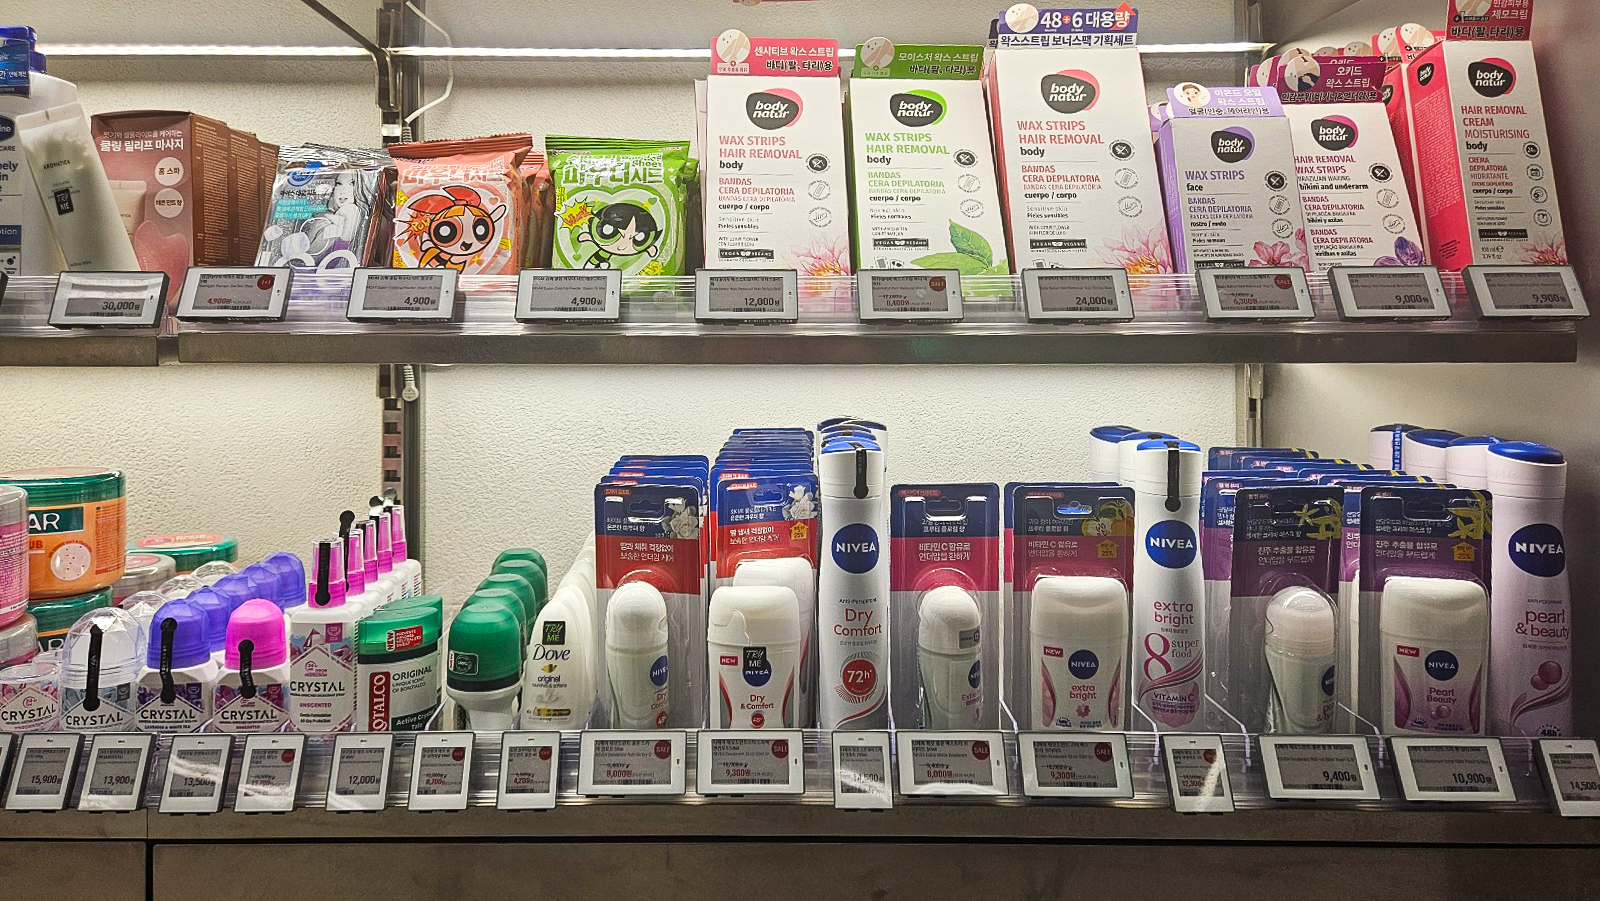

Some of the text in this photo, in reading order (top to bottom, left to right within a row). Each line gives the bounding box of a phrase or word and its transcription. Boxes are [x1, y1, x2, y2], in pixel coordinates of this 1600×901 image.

[1085, 12, 1131, 29] 대용량
[1000, 35, 1050, 47] 왁스스트립
[1052, 35, 1092, 47] 보너스팩
[1094, 34, 1133, 46] 기획세트
[754, 46, 834, 60] 센시티브 왁스 스트립
[898, 53, 978, 62] 모이스처 왁스 스트립
[1336, 66, 1362, 76] 오키드
[1476, 70, 1504, 81] body
[1326, 78, 1370, 89] 왁스 스트립
[1475, 78, 1506, 87] natur
[1051, 83, 1085, 95] body
[1049, 93, 1087, 102] natur
[755, 100, 788, 113] body
[898, 100, 932, 112] body
[1460, 105, 1527, 115] HAIR REMOVAL
[752, 110, 790, 120] natur
[897, 108, 934, 117] natur
[1017, 121, 1086, 131] WAX STRIPS
[1462, 118, 1494, 126] CREAM
[1319, 125, 1346, 135] body
[719, 135, 786, 146] WAX STRIPS
[865, 133, 932, 142] WAX STRIPS
[1019, 134, 1105, 144] HAIR REMOVAL
[1318, 133, 1348, 142] natur
[99, 138, 184, 152] 쿨링 릴리프 마사지
[1218, 138, 1243, 148] body
[1466, 141, 1488, 152] body
[719, 148, 802, 159] HAIR REMOVAL
[866, 144, 950, 155] HAIR REMOVAL
[1020, 147, 1045, 157] body
[1217, 145, 1246, 153] natur
[866, 155, 891, 165] body
[1316, 155, 1356, 164] REMOVAL
[719, 160, 744, 171] body
[1021, 165, 1056, 173] BANDAS
[1314, 166, 1346, 174] STRIPS
[868, 171, 901, 179] BANDAS
[1023, 175, 1101, 183] CERA DEPILATORIA
[1185, 170, 1245, 180] WAX STRIPS
[719, 178, 752, 186] BANDAS
[1186, 183, 1203, 191] face
[741, 187, 795, 195] DEPILATORIA
[1024, 192, 1077, 200] cuerpo corpo
[1187, 197, 1216, 205] BANDAS
[718, 204, 743, 212] cuerpo
[836, 542, 877, 553] NIVEA
[919, 542, 940, 552] 비타민
[941, 543, 948, 551] C
[1028, 540, 1049, 549] 비타민
[1050, 541, 1057, 549] C
[1149, 538, 1194, 549] NIVEA
[1515, 541, 1564, 554] NIVEA
[1153, 600, 1194, 612] extra
[845, 608, 874, 624] Dry
[1154, 612, 1194, 628] bright
[1525, 610, 1565, 625] pearl
[834, 624, 882, 637] Comfort
[1530, 625, 1571, 640] beauty
[546, 633, 560, 643] ME
[1171, 639, 1199, 650] super
[532, 643, 571, 661] Dove
[1171, 649, 1192, 658] food
[749, 660, 762, 668] ME
[1071, 660, 1096, 668] NIVEA
[1428, 662, 1455, 670] NIVEA
[392, 666, 433, 681] ORIGINAL
[537, 675, 561, 684] original
[290, 681, 345, 692] CRYSTAL
[1070, 690, 1097, 700] bright
[1429, 687, 1455, 697] Pearl
[750, 694, 765, 703] Dry
[1426, 695, 1457, 707] Beauty
[1, 705, 56, 721] CRYSTAL
[140, 709, 196, 720] CRYSTAL
[221, 710, 277, 720] CRYSTAL
[66, 712, 123, 727] CRYSTAL
[726, 769, 751, 777] 9,300원
